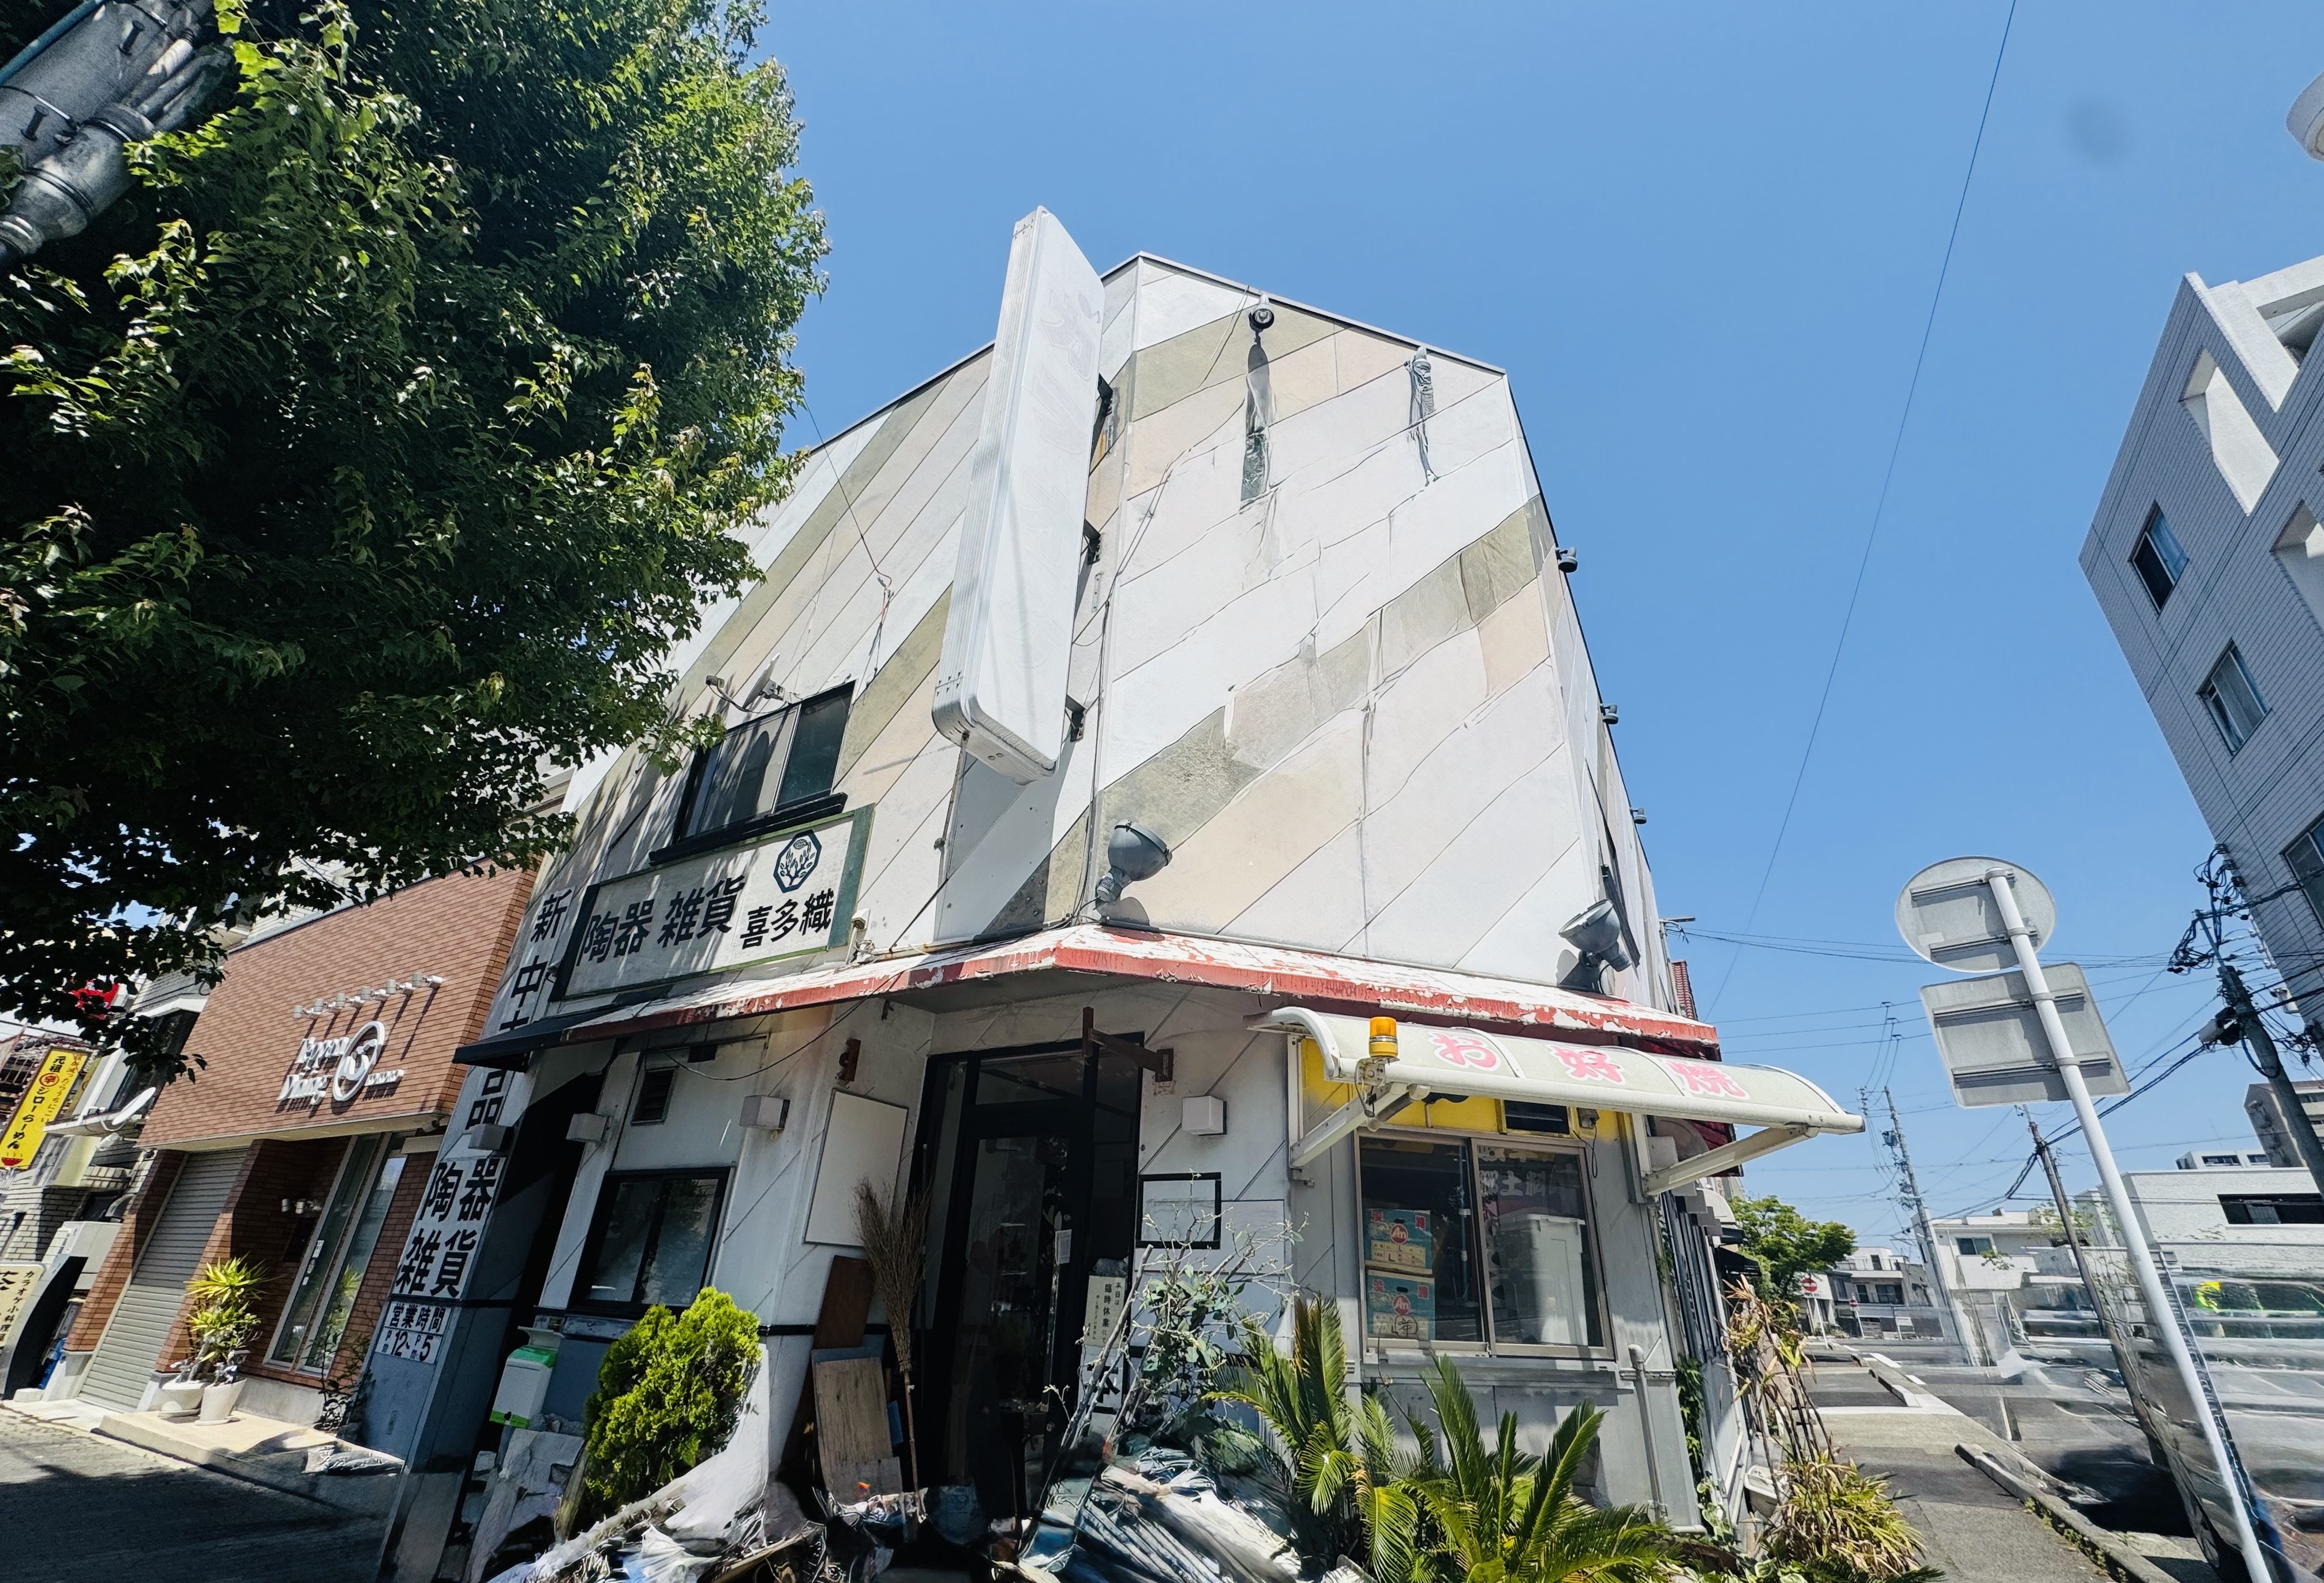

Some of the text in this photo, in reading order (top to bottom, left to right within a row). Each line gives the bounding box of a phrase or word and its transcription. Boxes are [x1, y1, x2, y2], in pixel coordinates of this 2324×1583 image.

[419, 1158, 500, 1222] 陶器
[396, 1228, 477, 1298] 雑貨
[389, 1303, 447, 1333] 営業時間
